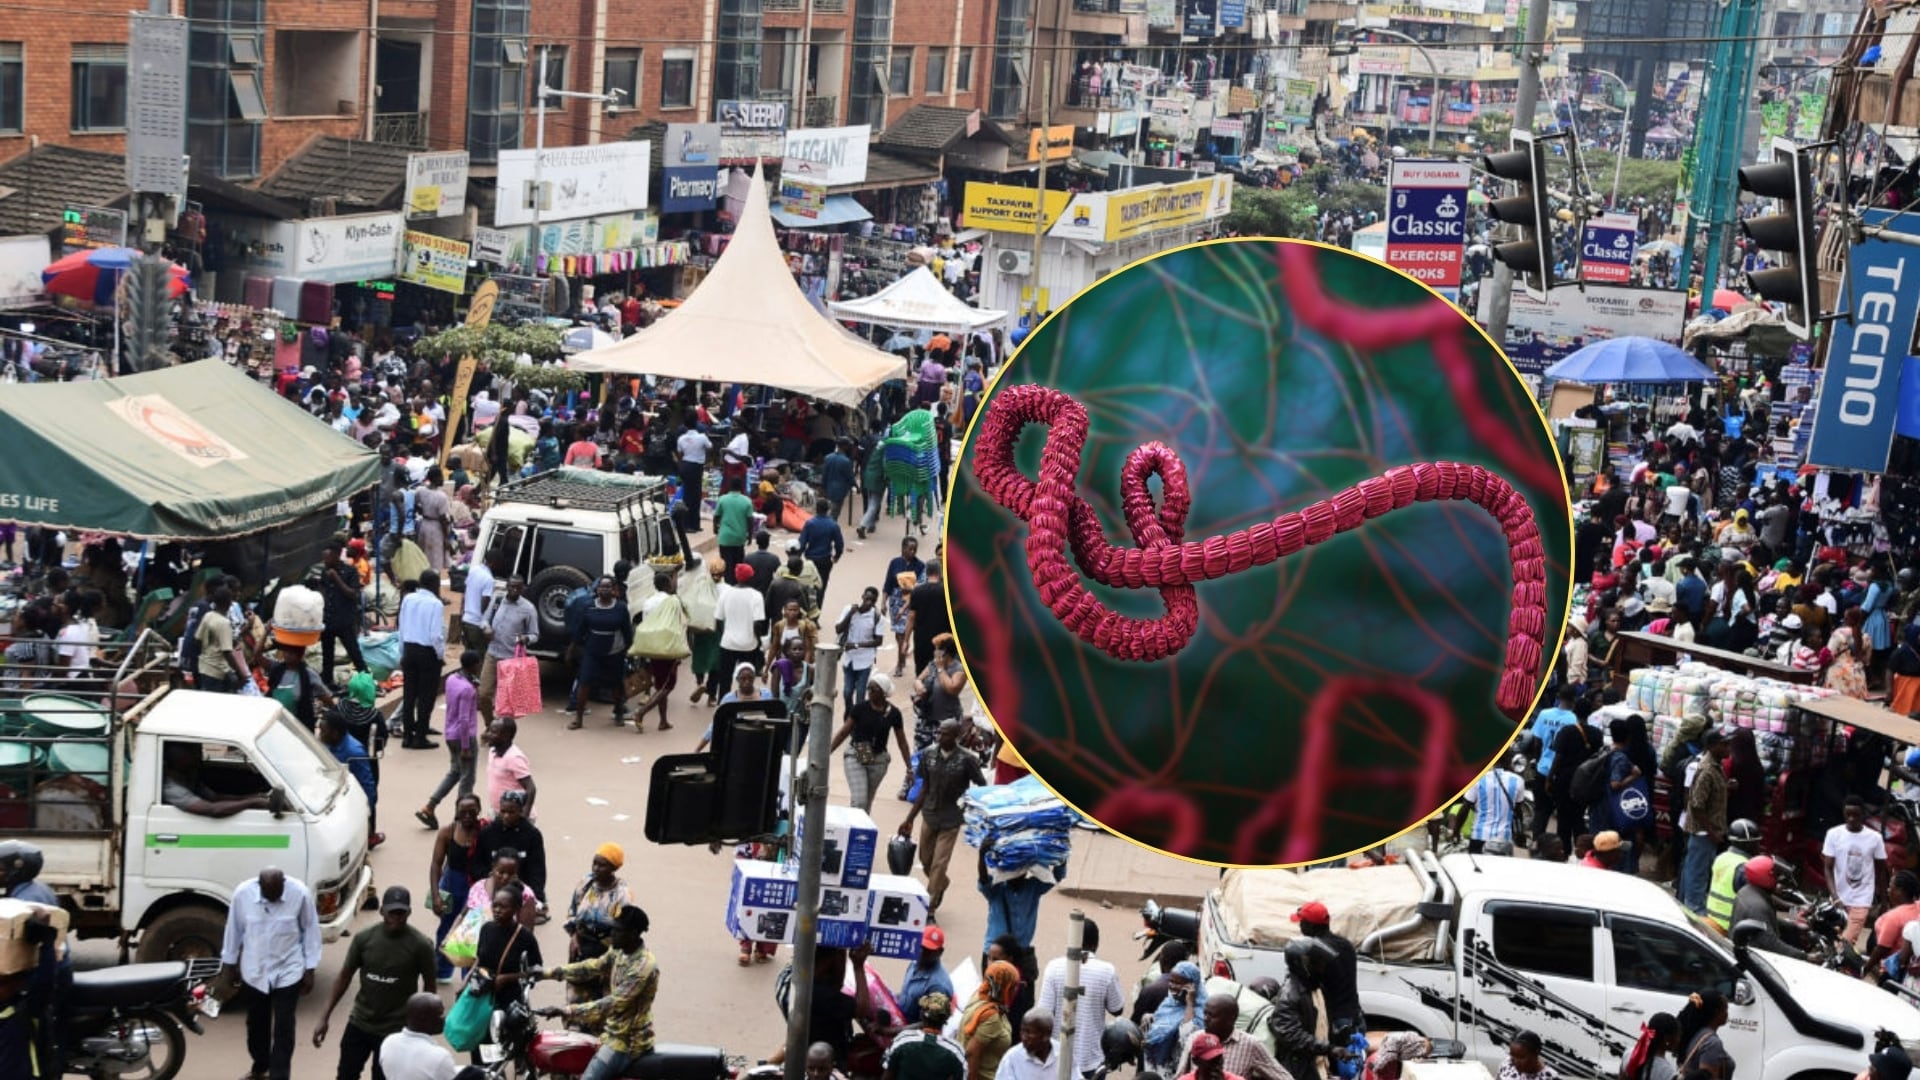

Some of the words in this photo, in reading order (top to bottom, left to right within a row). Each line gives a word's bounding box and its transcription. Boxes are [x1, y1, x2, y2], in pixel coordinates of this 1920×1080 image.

[788, 137, 849, 167] ELEGANT
[670, 176, 716, 200] Pharmacy
[987, 197, 1033, 208] TAXPAYER
[970, 207, 1011, 217] SUPPORT
[1013, 211, 1049, 221] CENTE
[1391, 214, 1462, 236] Classic
[434, 238, 468, 254] STUDIO
[1583, 243, 1631, 260] Classic
[1390, 250, 1457, 261] EXERCISE
[1839, 257, 1905, 426] TECNO
[25, 495, 59, 513] LIFE
